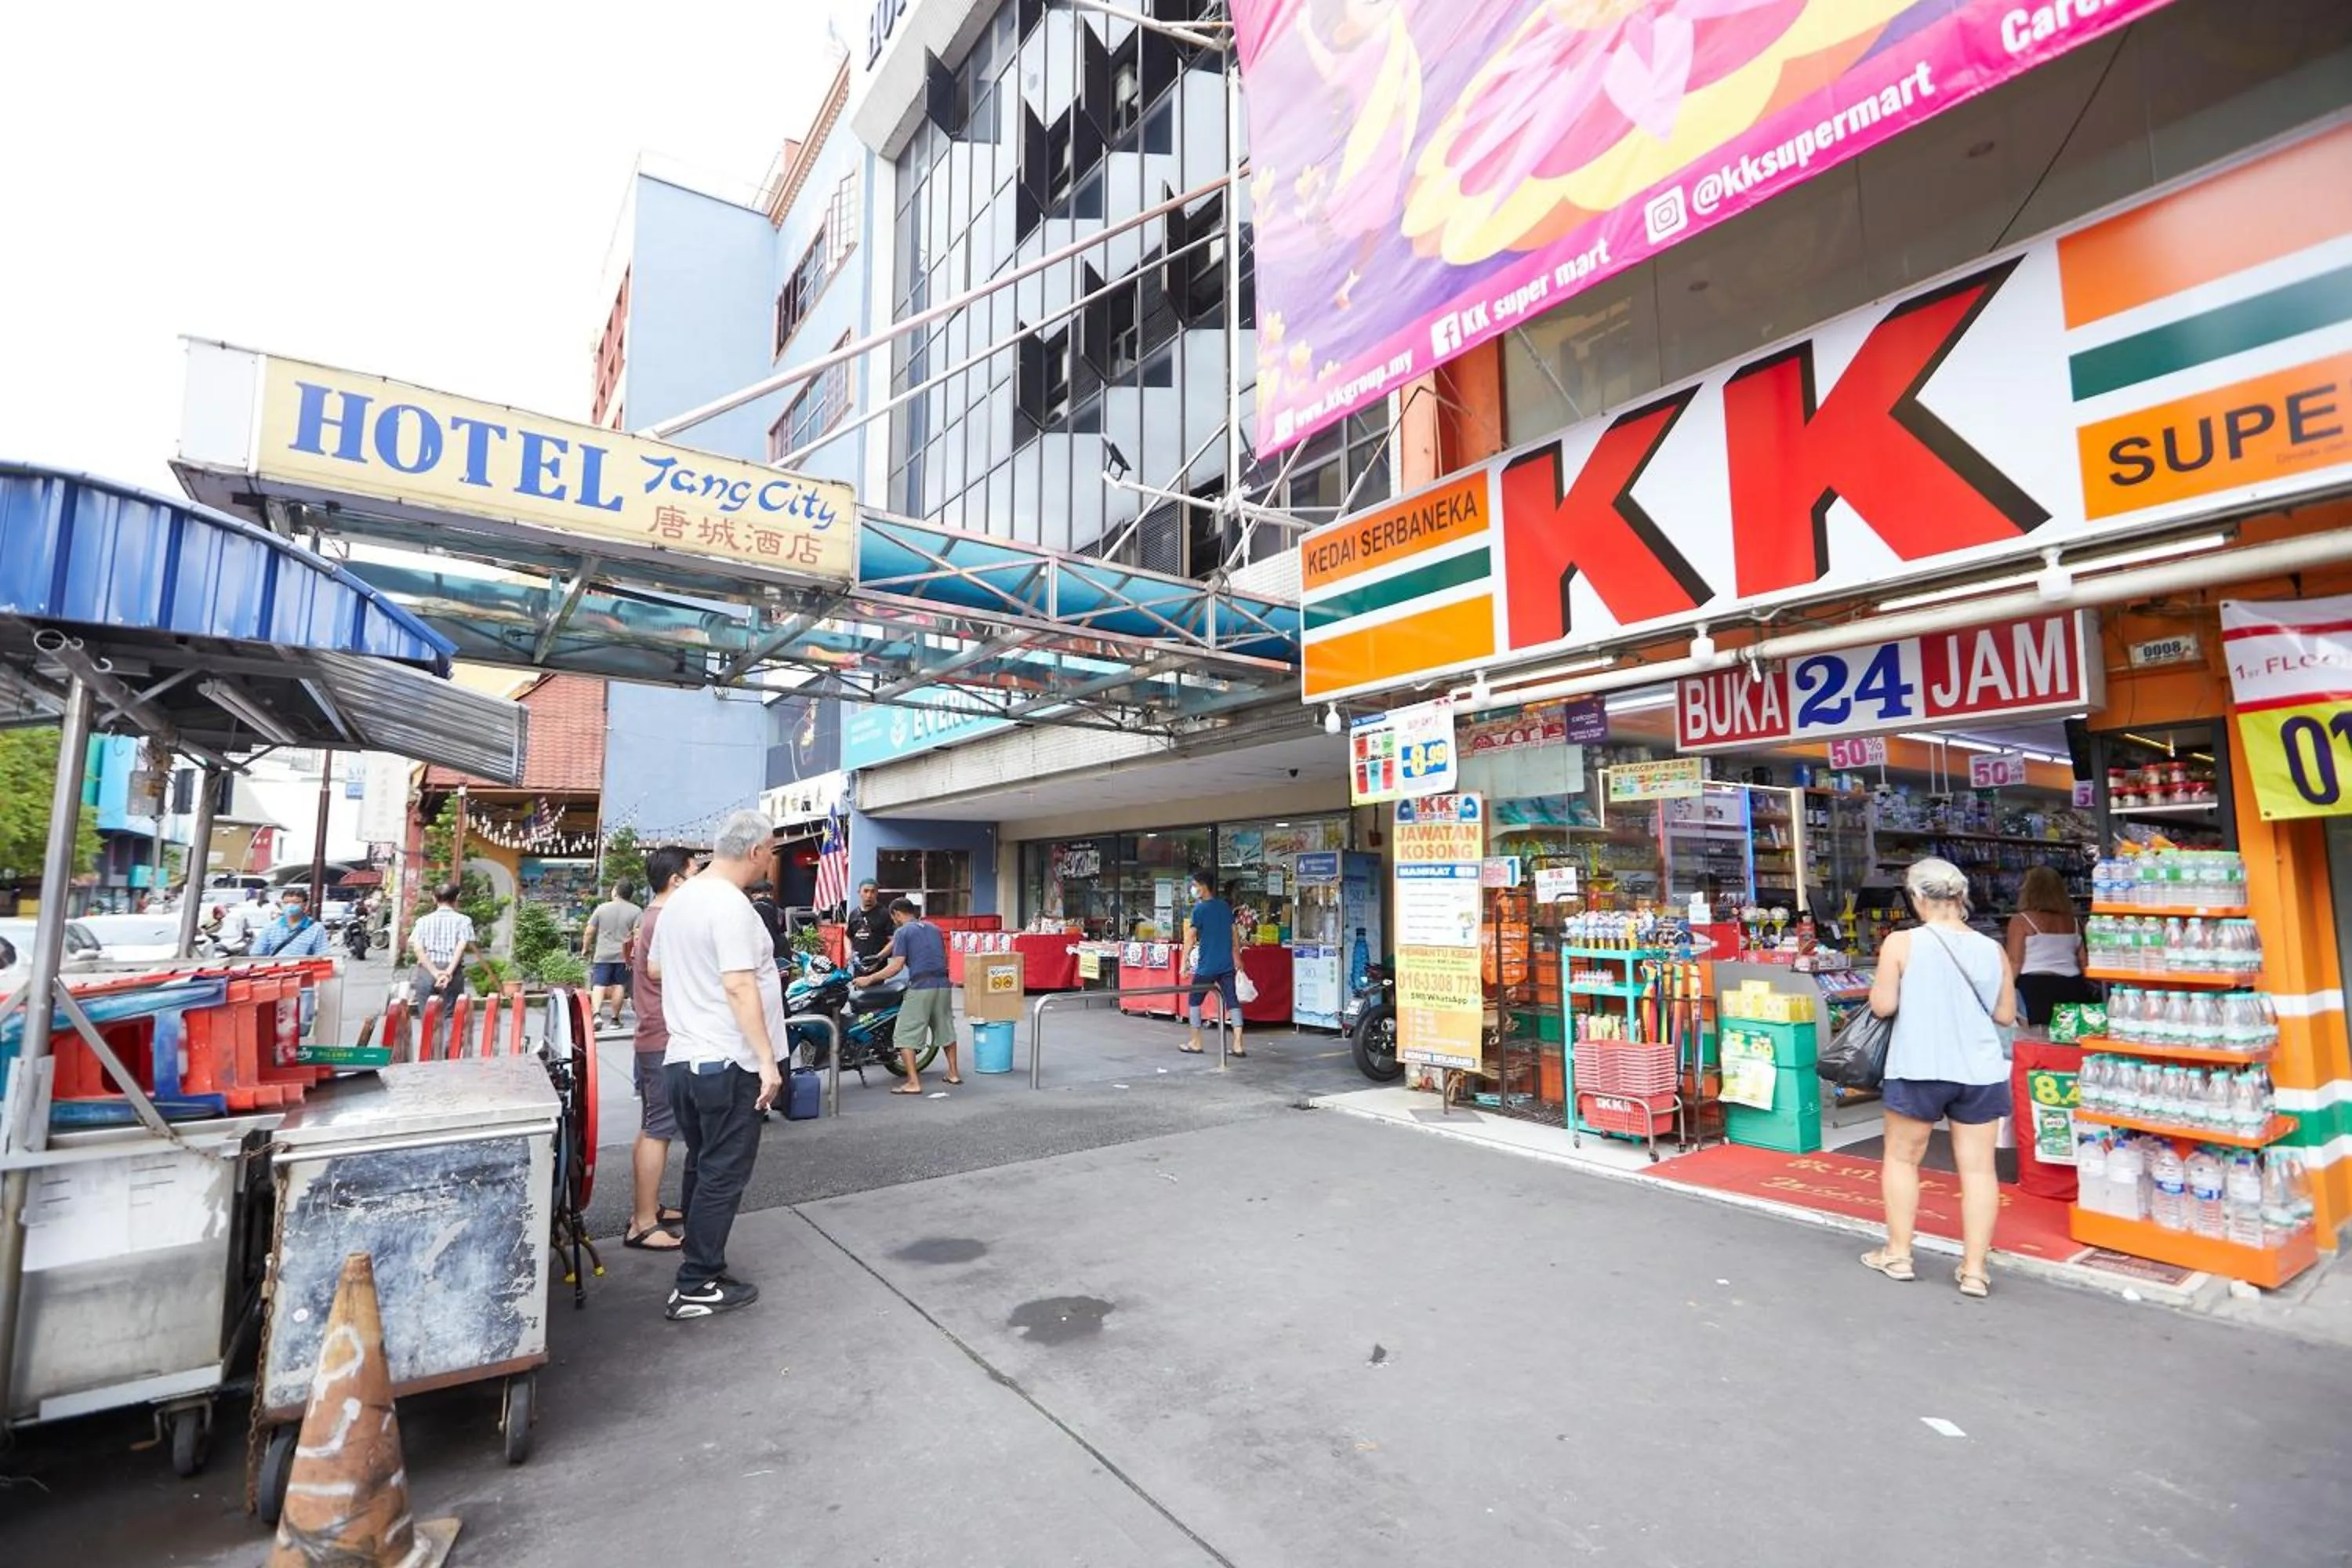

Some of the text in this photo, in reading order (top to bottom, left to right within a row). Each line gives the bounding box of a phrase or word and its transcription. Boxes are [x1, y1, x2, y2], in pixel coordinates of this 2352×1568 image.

[1691, 60, 1936, 216] @kksupermart
[1461, 237, 1611, 338] KK super mart
[1294, 348, 1414, 430] www.kkgroup.my
[289, 380, 625, 513] HOTEL
[757, 480, 837, 531] City
[1501, 252, 2053, 651] KK
[2108, 382, 2352, 487] SUPE
[648, 504, 823, 566] 唐城酒店
[1308, 490, 1478, 575] KEDAI SERBANEKA
[1685, 616, 2069, 740] BUKA 24 JAM
[2143, 640, 2181, 658] 0008
[1831, 738, 1867, 768] 50
[1974, 761, 2009, 786] 50
[1419, 797, 1452, 813] KK
[2078, 786, 2094, 805] 5
[1396, 826, 1478, 842] JAWATAN
[1400, 844, 1473, 860] KOSONG
